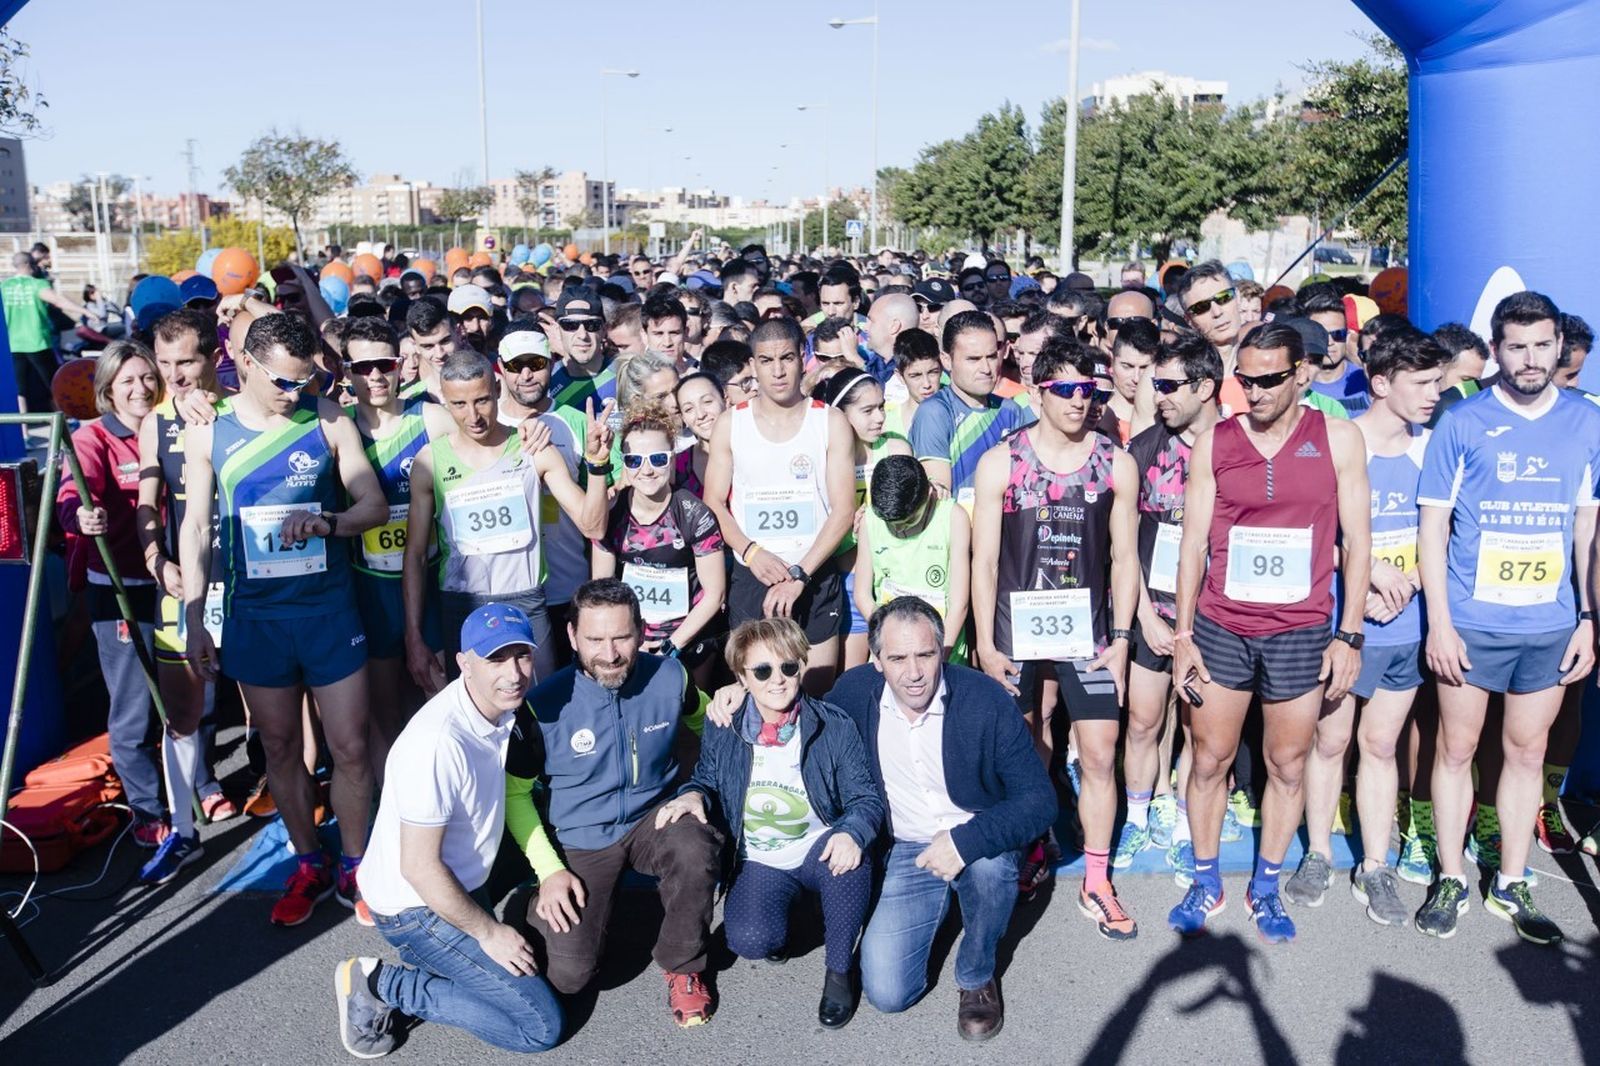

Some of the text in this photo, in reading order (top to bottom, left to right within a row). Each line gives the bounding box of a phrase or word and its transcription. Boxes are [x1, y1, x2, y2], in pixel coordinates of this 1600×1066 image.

[1480, 500, 1512, 511] CLUB
[468, 506, 512, 531] 398
[758, 510, 799, 530] 239
[1253, 555, 1284, 577] 98
[1499, 560, 1547, 581] 875
[634, 585, 673, 606] 344
[1031, 614, 1074, 636] 333
